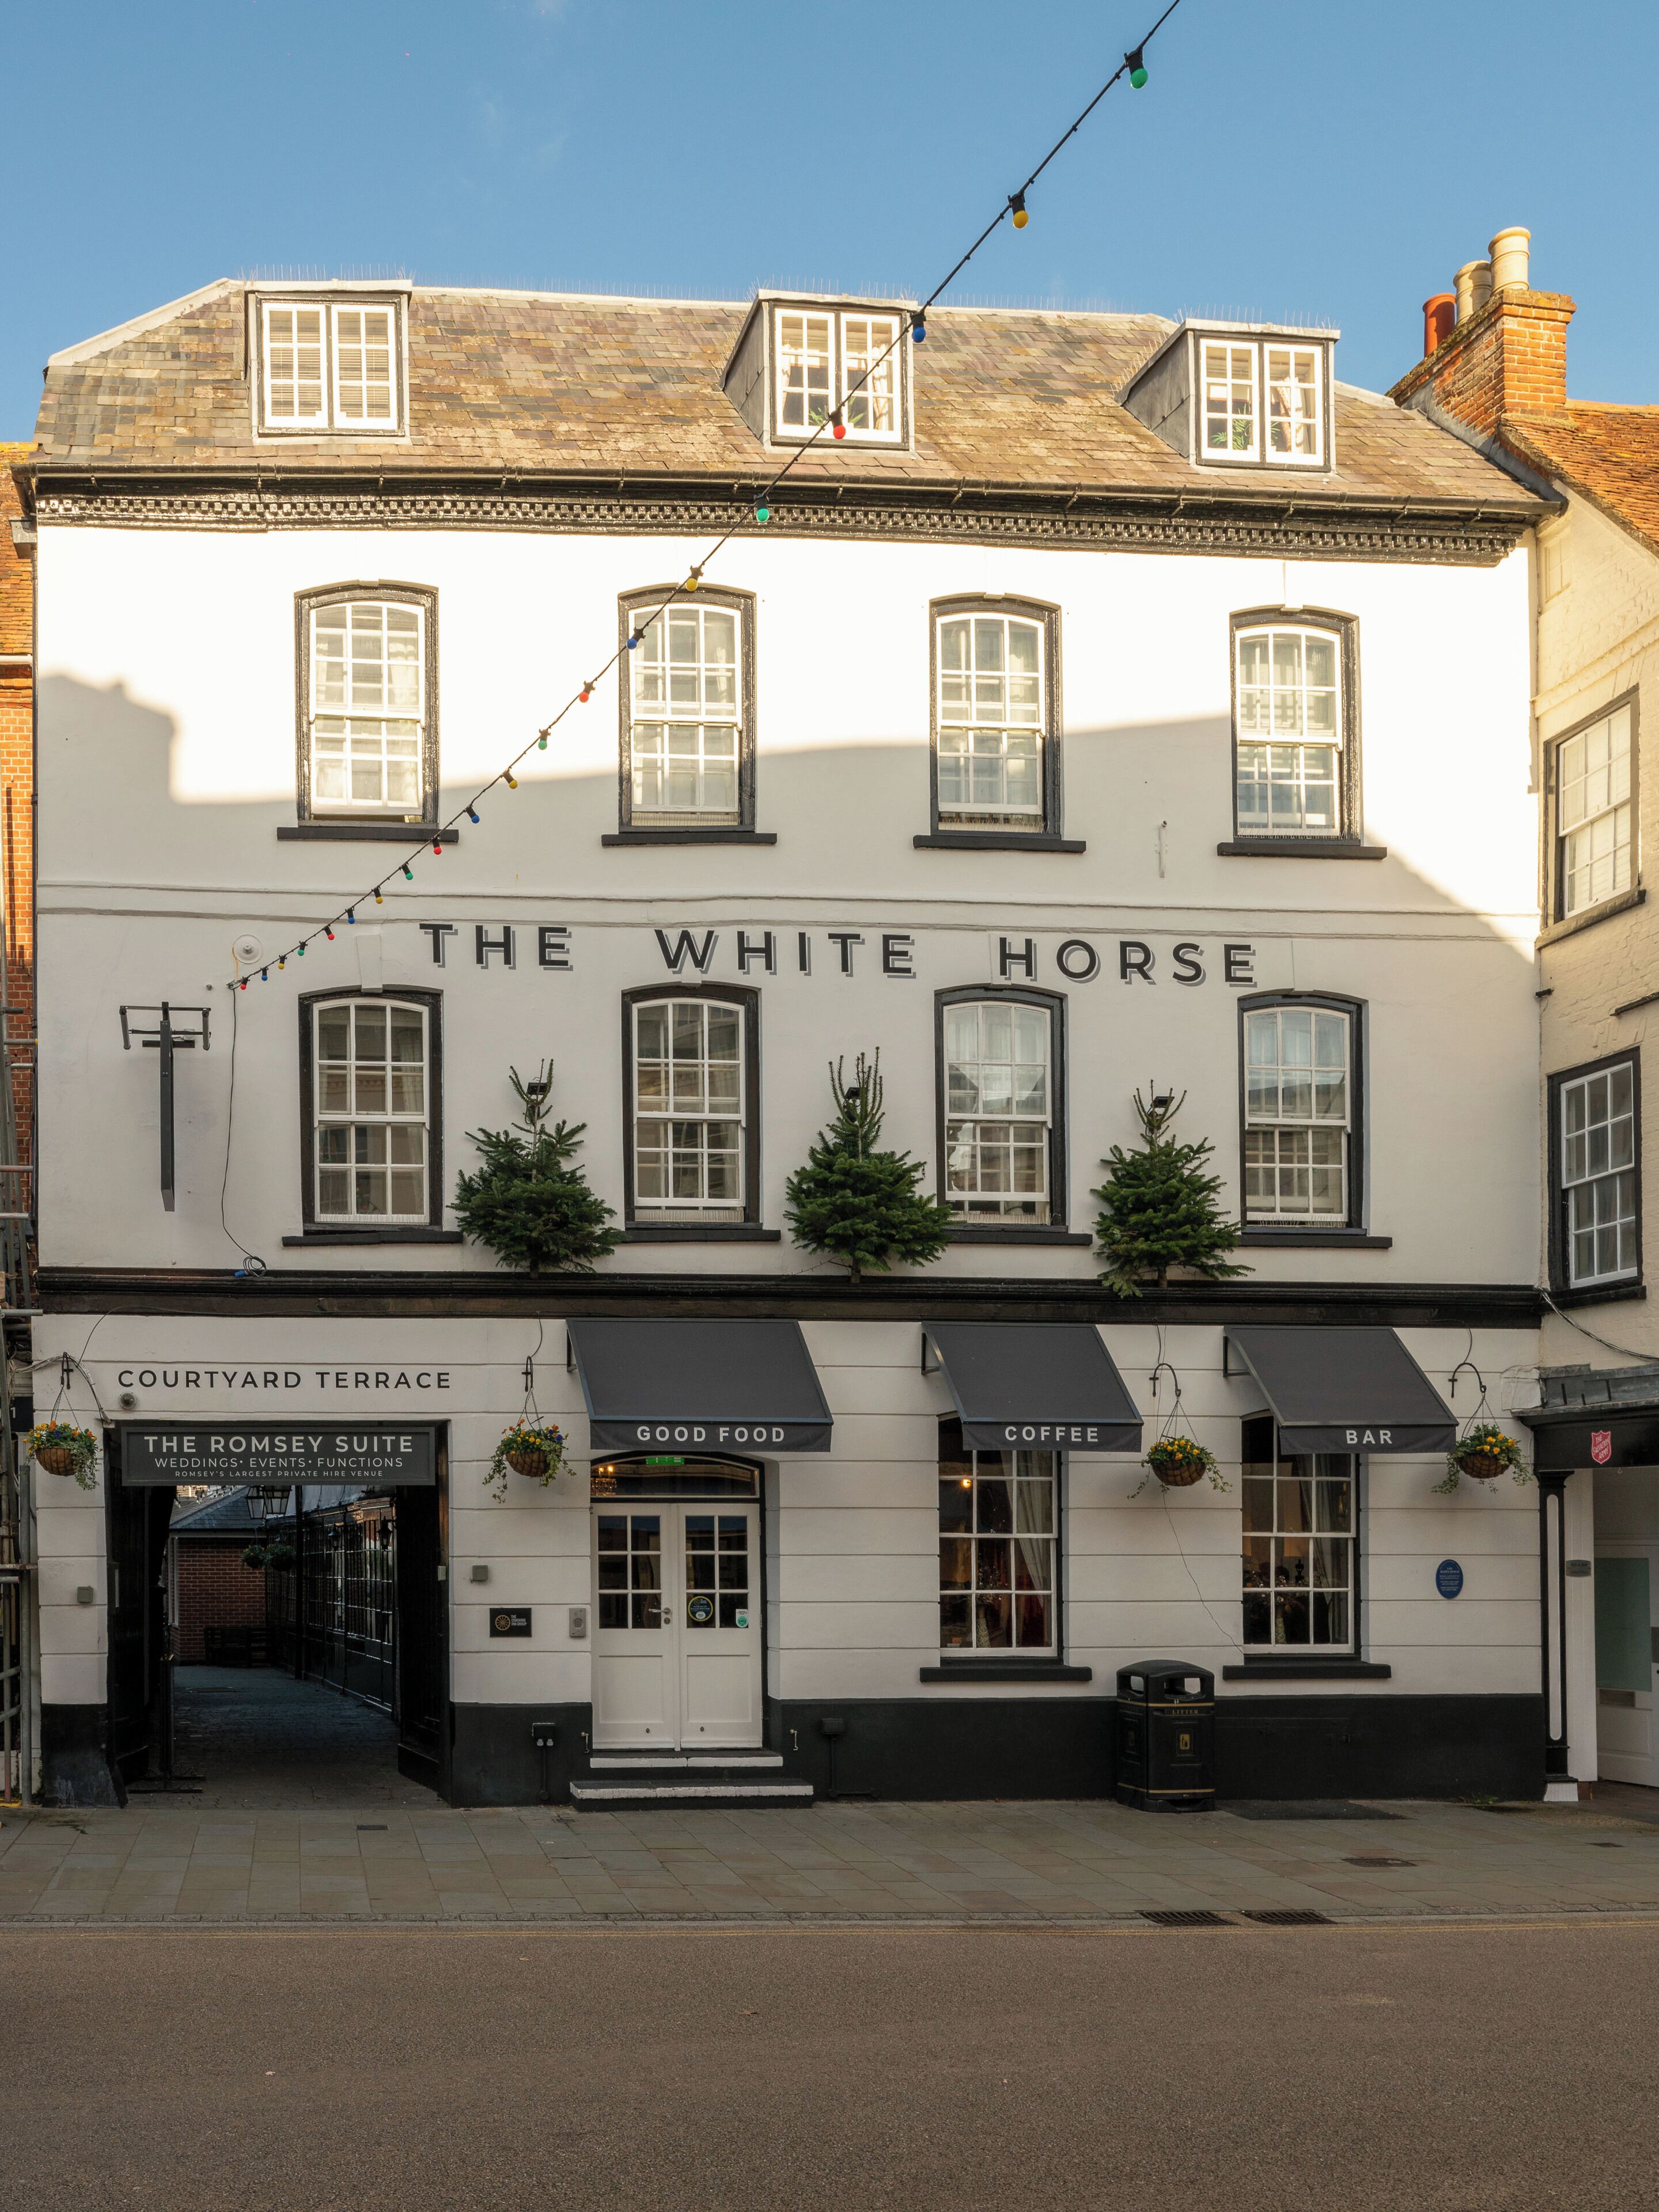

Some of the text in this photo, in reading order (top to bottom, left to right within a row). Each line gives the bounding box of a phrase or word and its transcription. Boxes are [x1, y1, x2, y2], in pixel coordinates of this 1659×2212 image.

[419, 923, 1257, 987] THE WHITE HORSE
[118, 1370, 450, 1389] COURTYARD TERRACE
[637, 1426, 785, 1442] GOOD FOOD
[1005, 1426, 1099, 1442] COFFEE
[1346, 1430, 1393, 1444] BAR
[144, 1436, 412, 1452] THE ROMSEY SUITE
[1593, 1437, 1610, 1456] SALVATION
[1599, 1446, 1609, 1460] ARMY
[317, 1457, 403, 1467] FUNCTIONS
